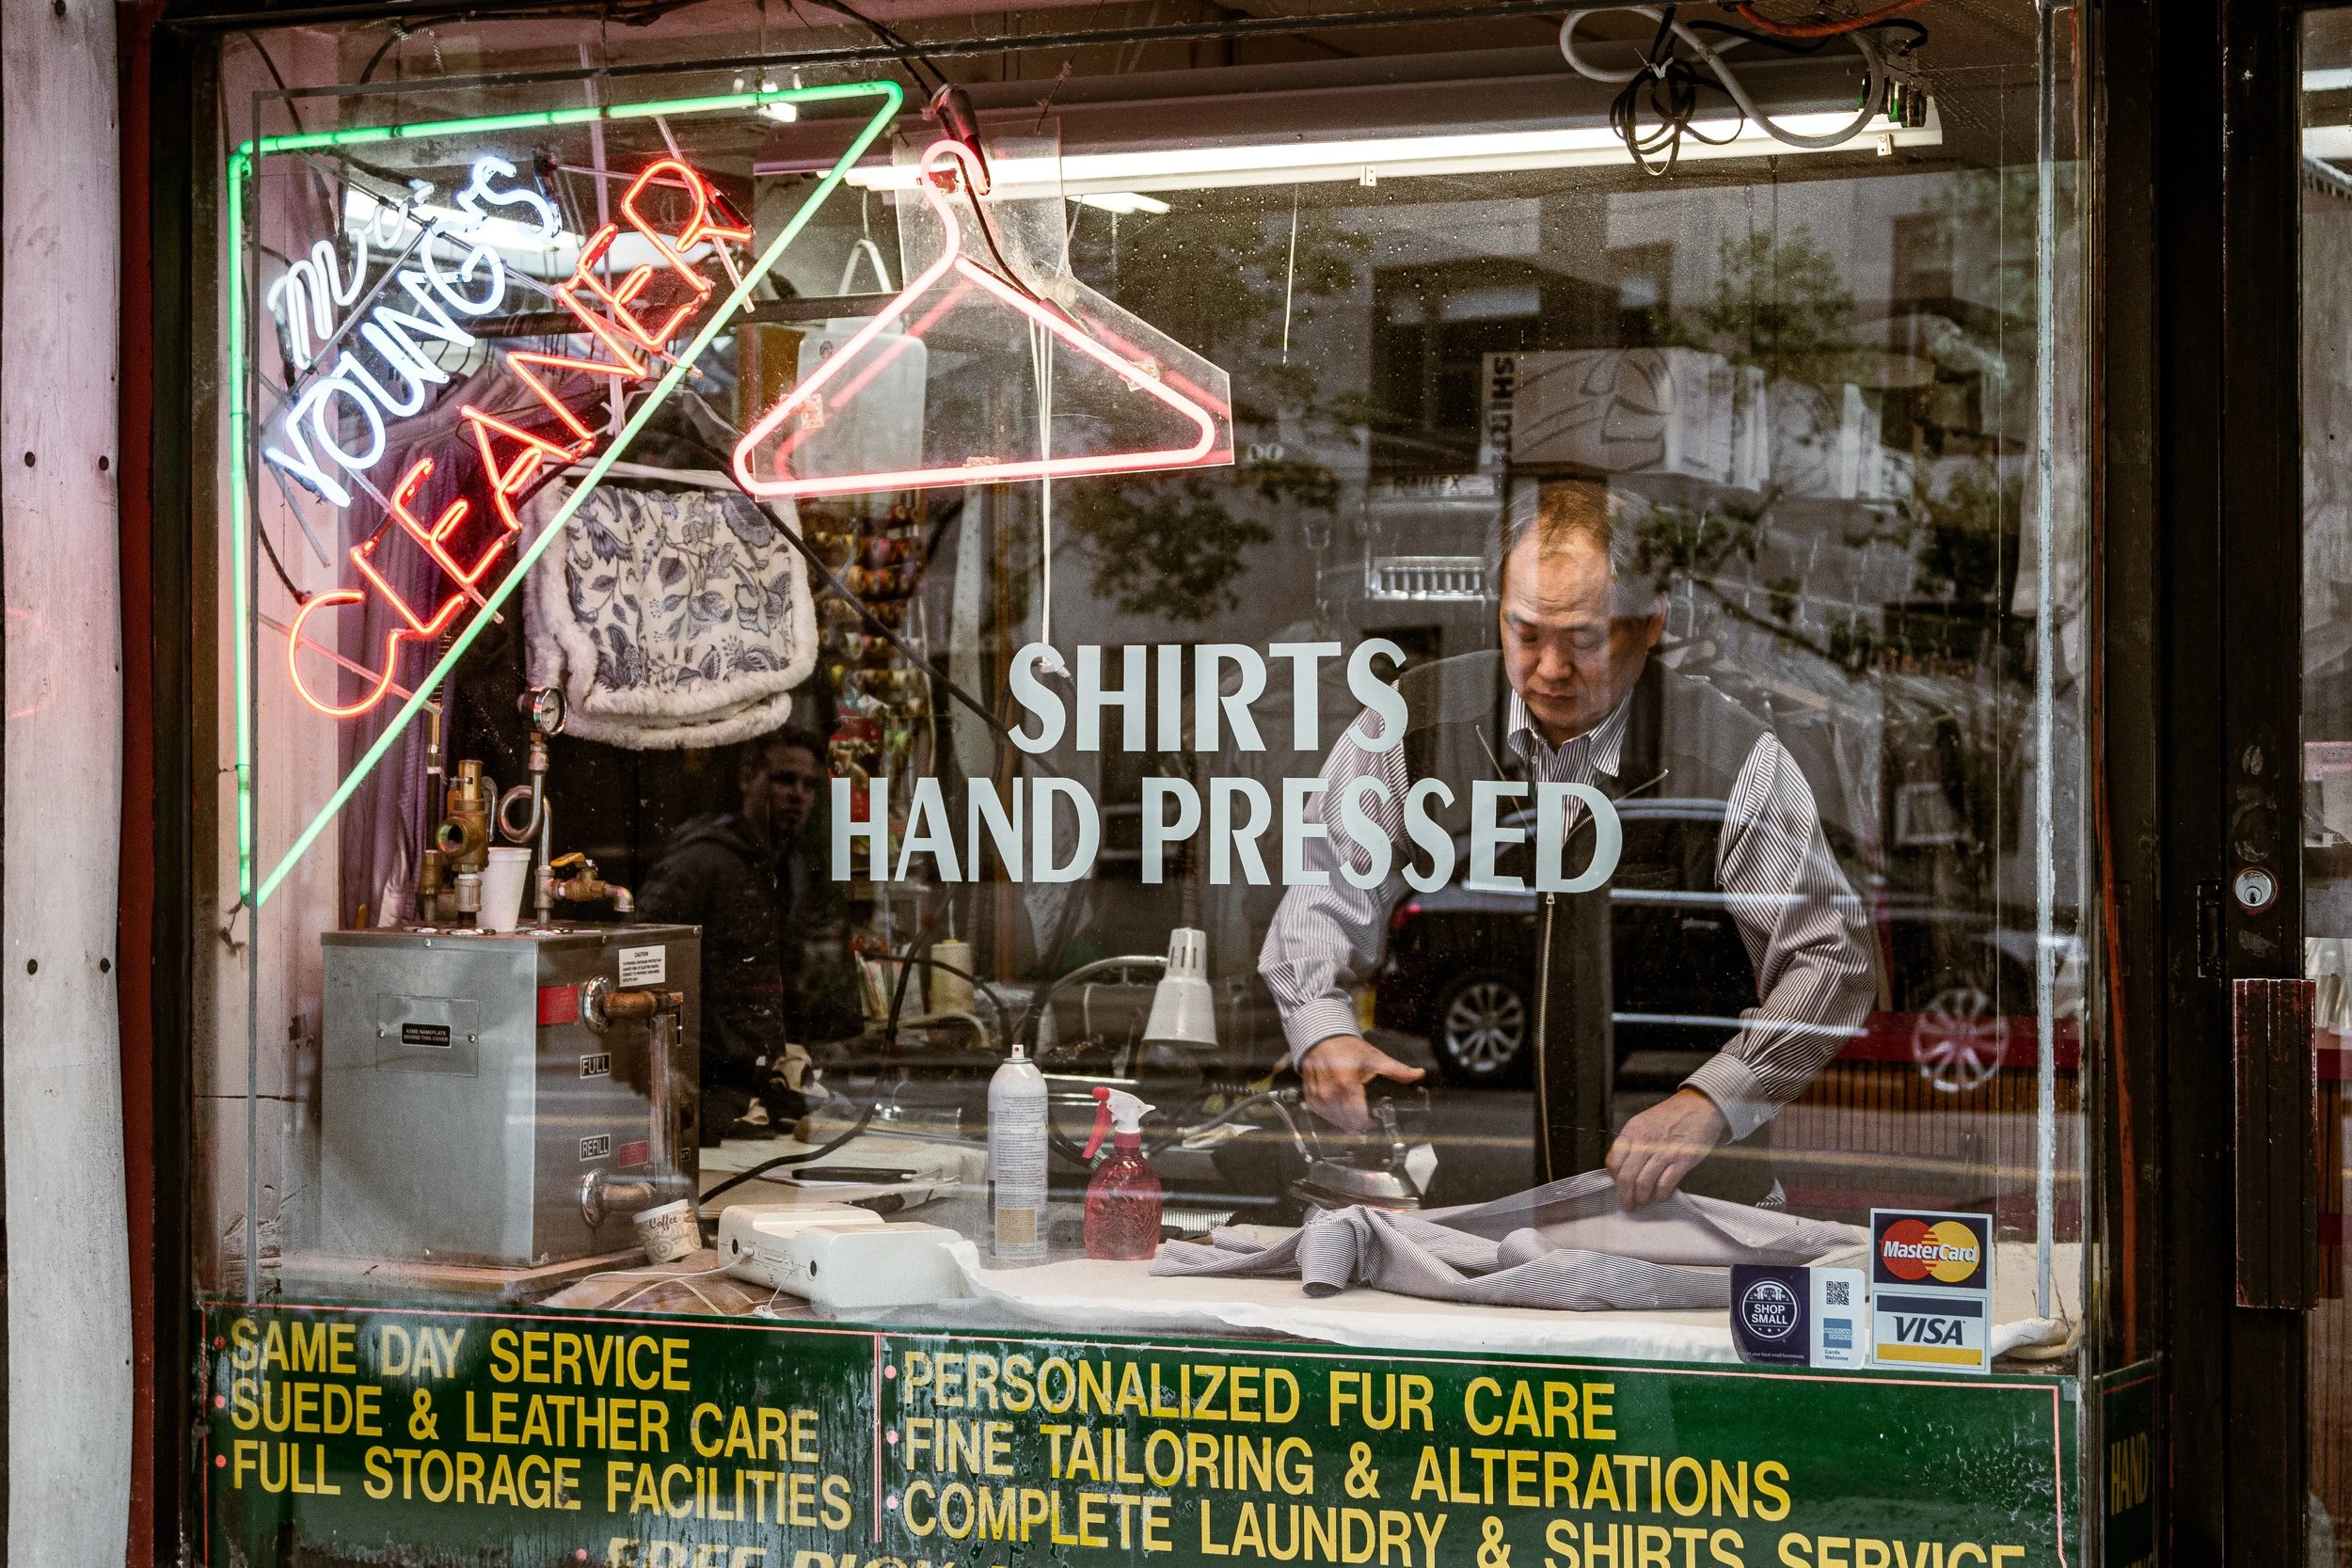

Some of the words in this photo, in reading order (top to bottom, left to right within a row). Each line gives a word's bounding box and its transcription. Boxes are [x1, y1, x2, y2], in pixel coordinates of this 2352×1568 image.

[287, 158, 753, 717] CLEANER
[1008, 638, 1408, 753] SHIRTS
[831, 776, 1101, 883] HAND
[1141, 775, 1624, 894] PRESSED
[582, 1055, 609, 1074] FULL
[582, 1136, 609, 1158] REFILL
[649, 1214, 677, 1230] Coffee
[1883, 1240, 1979, 1263] MasterCard
[1751, 1313, 1788, 1325] SMALL
[1754, 1304, 1786, 1315] SHOP
[1893, 1315, 1964, 1346] VISA
[230, 1318, 357, 1374] SAME
[381, 1325, 465, 1379] DAY
[489, 1327, 691, 1391] SERVICE
[904, 1351, 1300, 1424] PERSONALIZED
[1330, 1370, 1435, 1431] FUR
[1465, 1376, 1616, 1441] CARE
[231, 1378, 383, 1436] SUEDE
[408, 1387, 439, 1440] &
[466, 1390, 670, 1452] LEATHER
[691, 1402, 820, 1464] CARE
[232, 1439, 342, 1496] FULL
[363, 1448, 581, 1511] STORAGE
[607, 1460, 852, 1531] FACILITIES
[905, 1418, 1014, 1477] FINE
[1040, 1424, 1314, 1497] TAILORING
[1344, 1440, 1380, 1499] &
[1411, 1446, 1790, 1522] ALTERATIONS
[2110, 1431, 2150, 1517] HAND
[902, 1480, 1173, 1552] COMPLETE
[1200, 1499, 1448, 1568] LAUNDRY
[1477, 1515, 1512, 1568] &
[1544, 1519, 1745, 1568] SHIRTS
